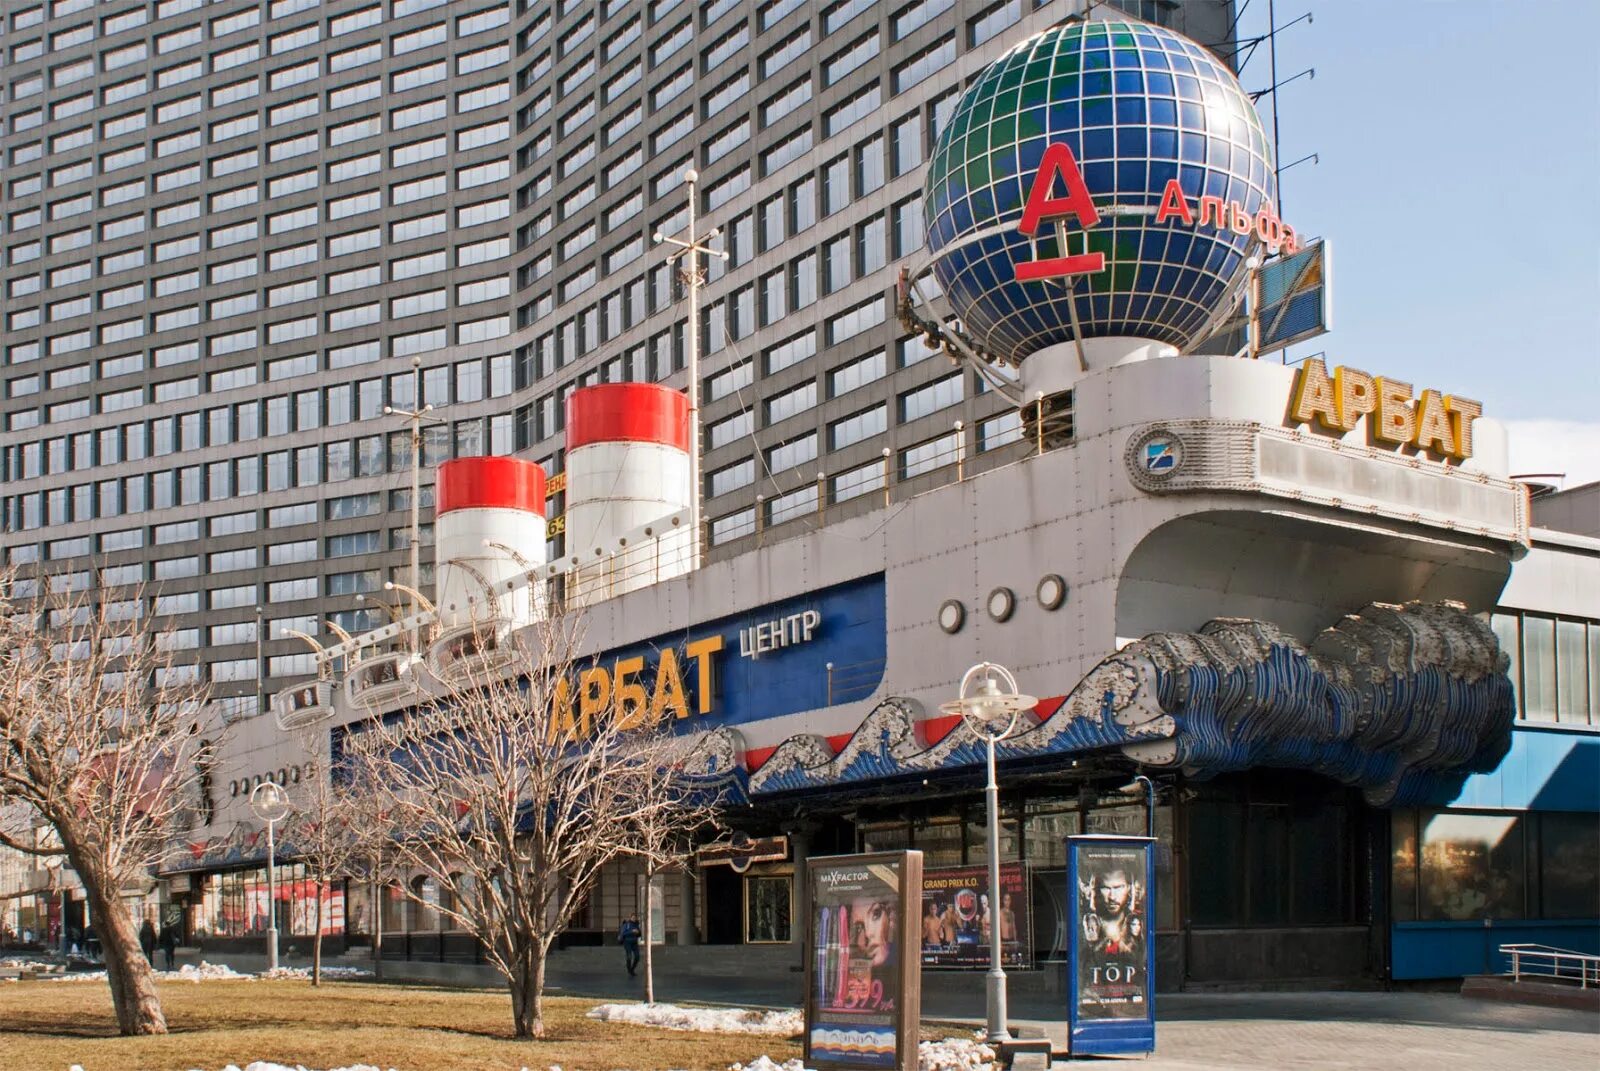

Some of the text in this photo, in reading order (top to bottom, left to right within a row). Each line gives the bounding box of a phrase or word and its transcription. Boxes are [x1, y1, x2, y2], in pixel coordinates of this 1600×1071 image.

[1017, 142, 1101, 237] А
[1155, 179, 1297, 255] Альфа
[1291, 358, 1482, 458] АРБАТ
[547, 635, 723, 747] АРБАТ
[740, 610, 820, 660] ЦЕНТР
[923, 880, 948, 889] GRAND
[948, 879, 964, 888] PRIX
